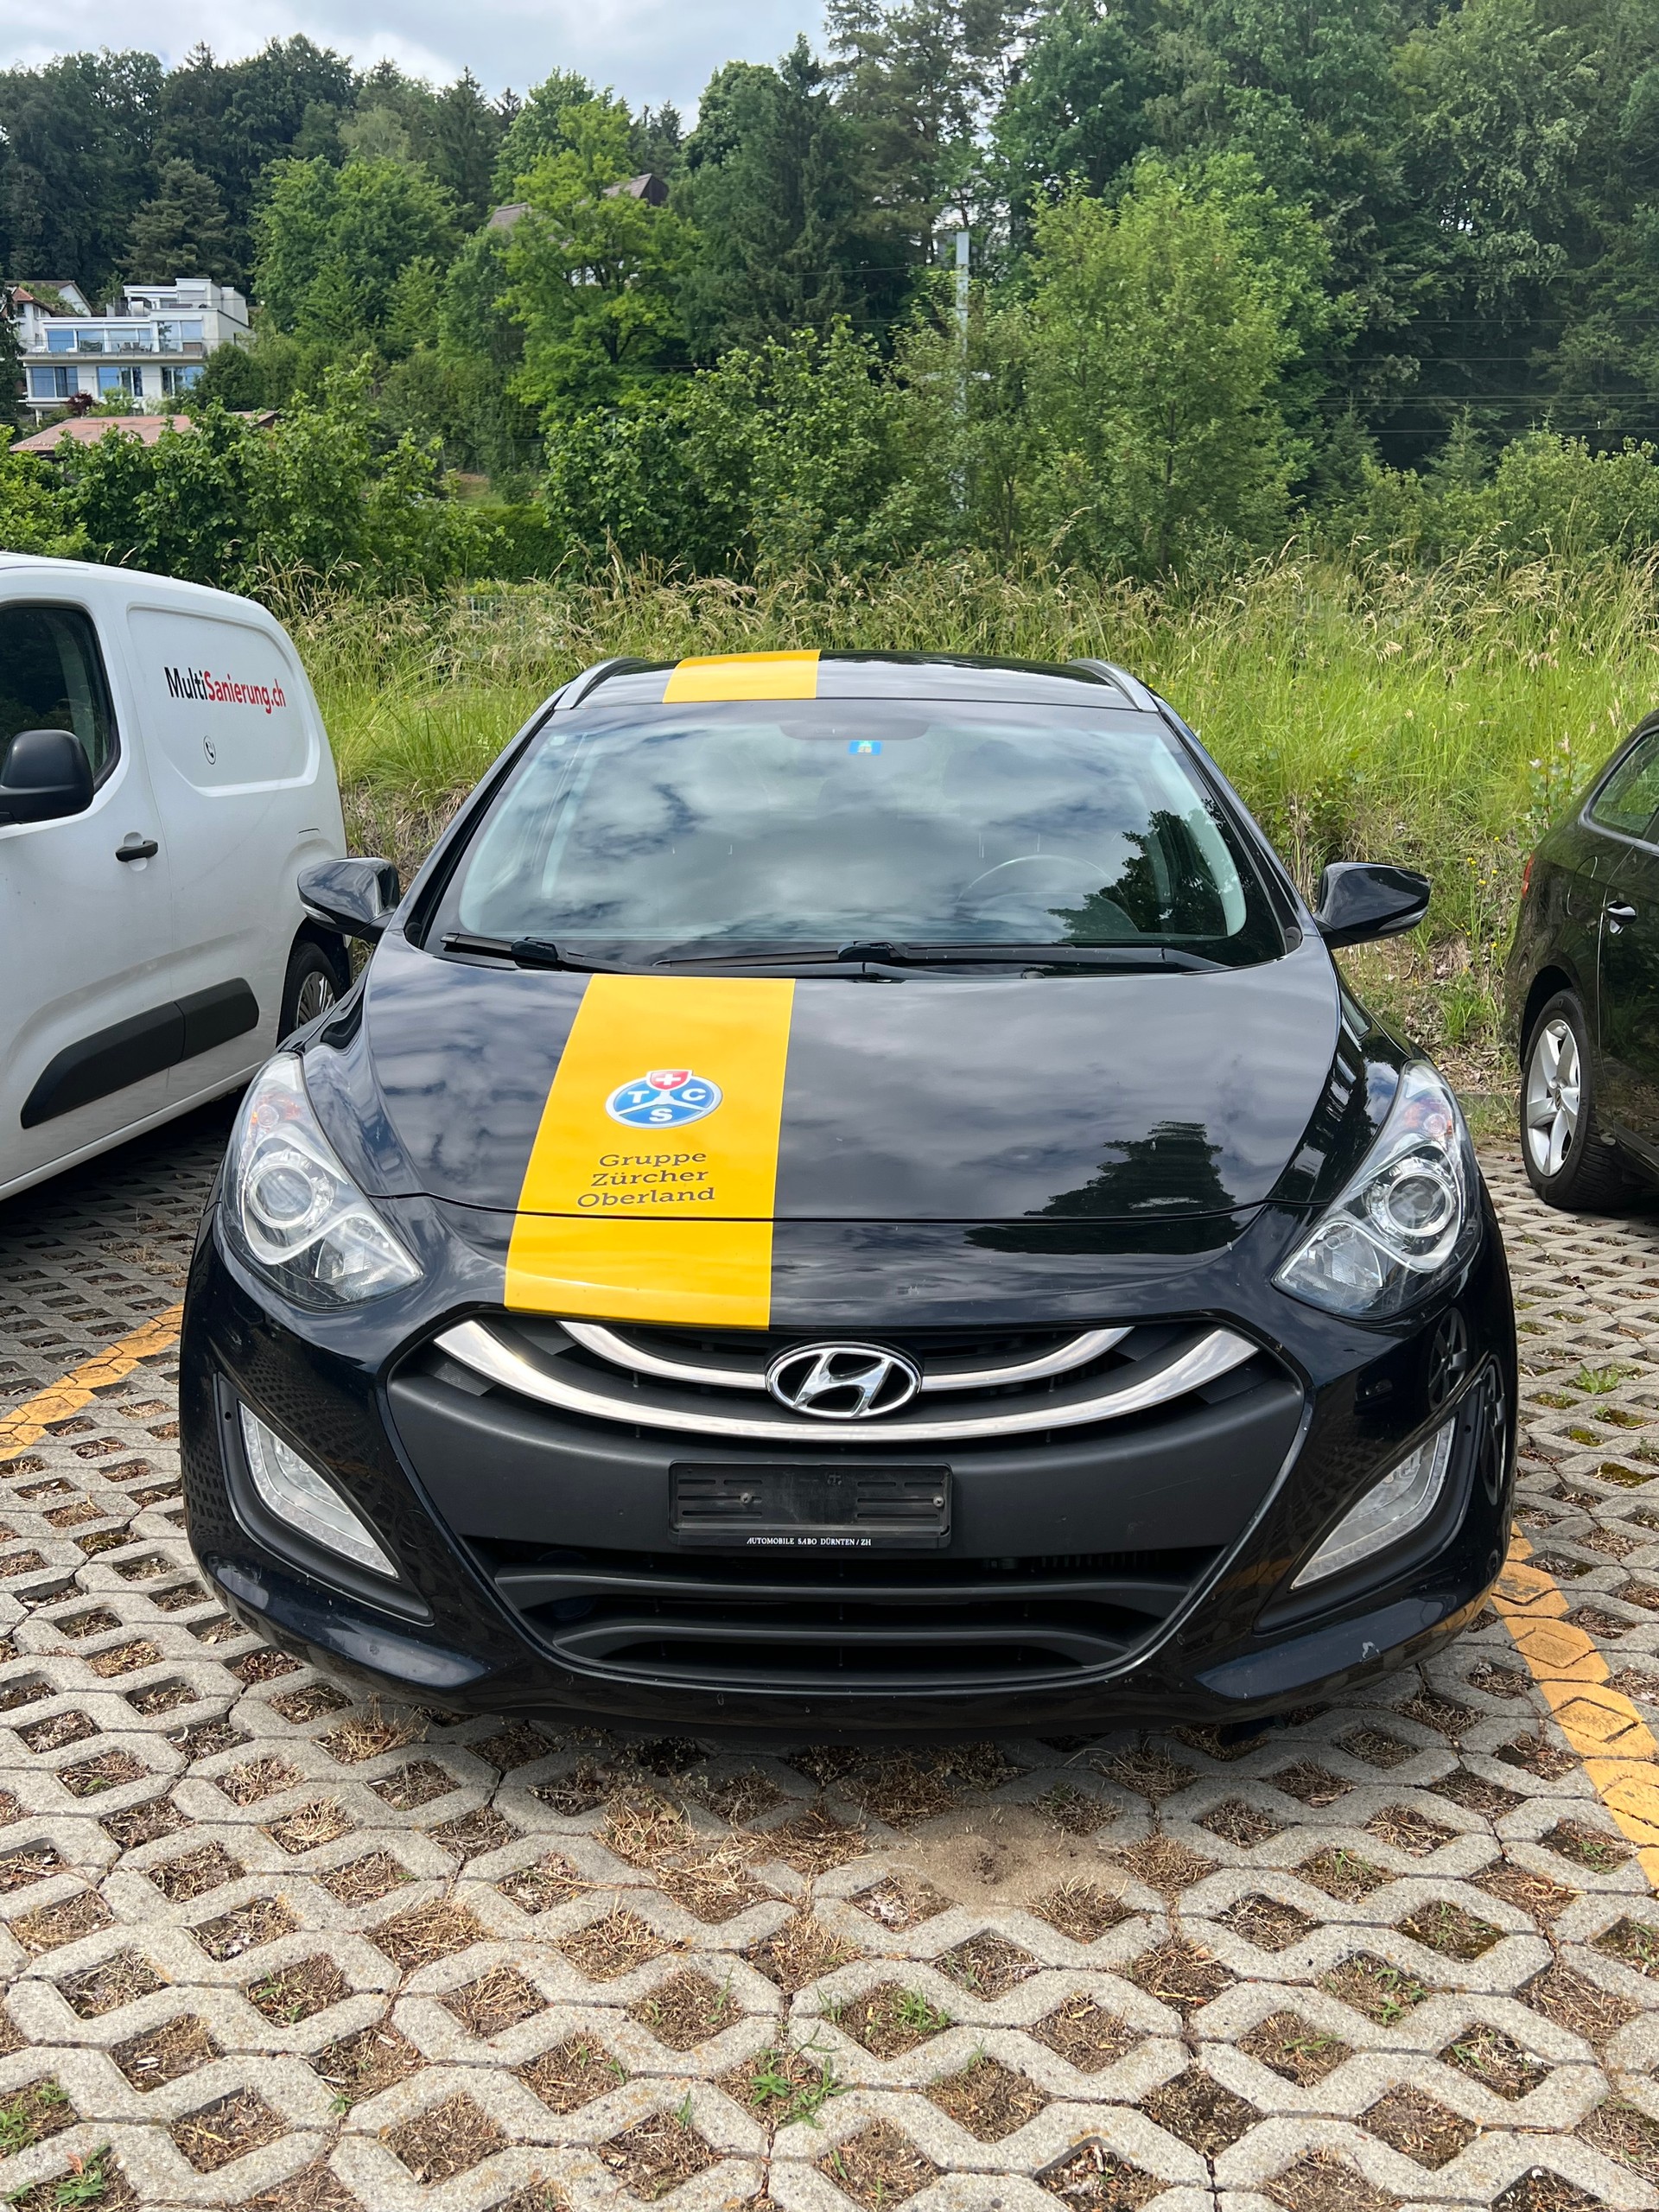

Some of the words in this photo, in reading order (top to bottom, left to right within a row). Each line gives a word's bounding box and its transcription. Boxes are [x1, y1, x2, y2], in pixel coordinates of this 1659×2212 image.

[164, 667, 286, 714] MultiSanierung.ch
[599, 1152, 707, 1166] Gruppe
[591, 1170, 709, 1186] Zürcher
[577, 1187, 715, 1207] Oberland
